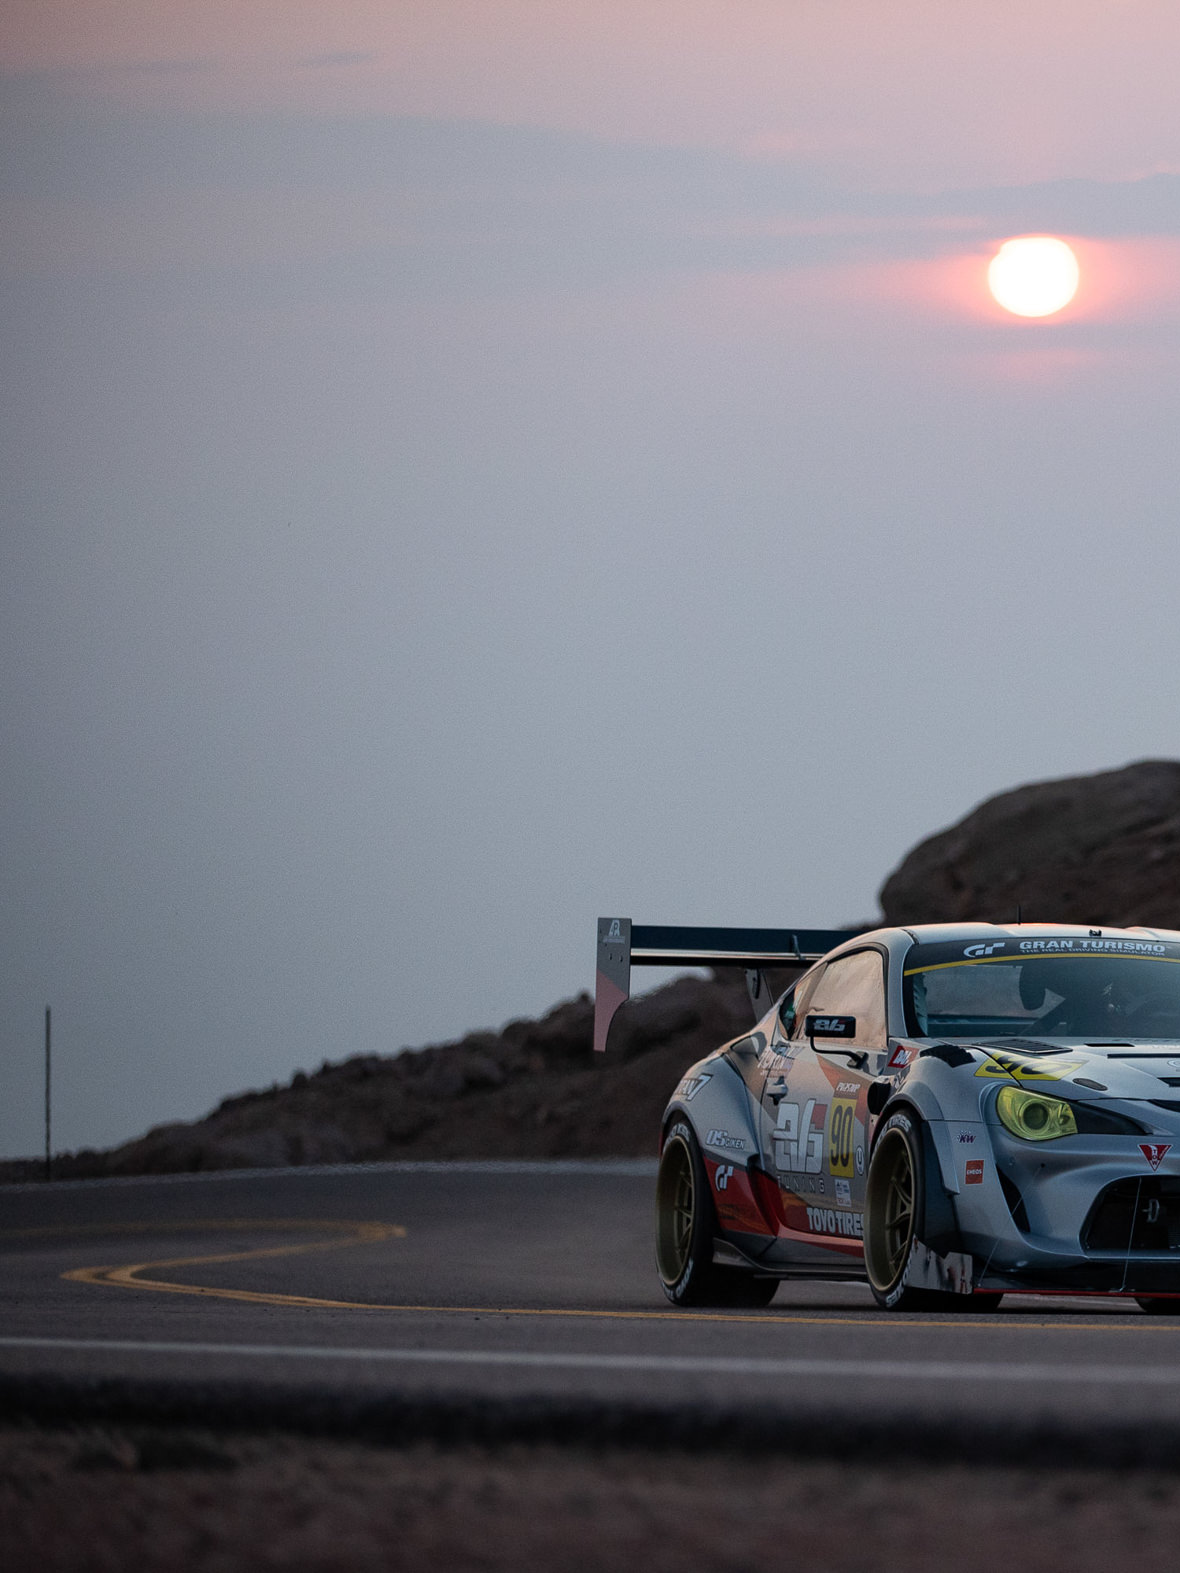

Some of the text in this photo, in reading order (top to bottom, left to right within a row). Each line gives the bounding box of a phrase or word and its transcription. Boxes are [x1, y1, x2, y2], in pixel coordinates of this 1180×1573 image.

[1019, 940, 1166, 953] GRAN TURISMO
[830, 1104, 854, 1168] 90
[958, 1132, 977, 1144] KW
[777, 1174, 826, 1194] TUNING
[806, 1207, 837, 1234] TOYO
